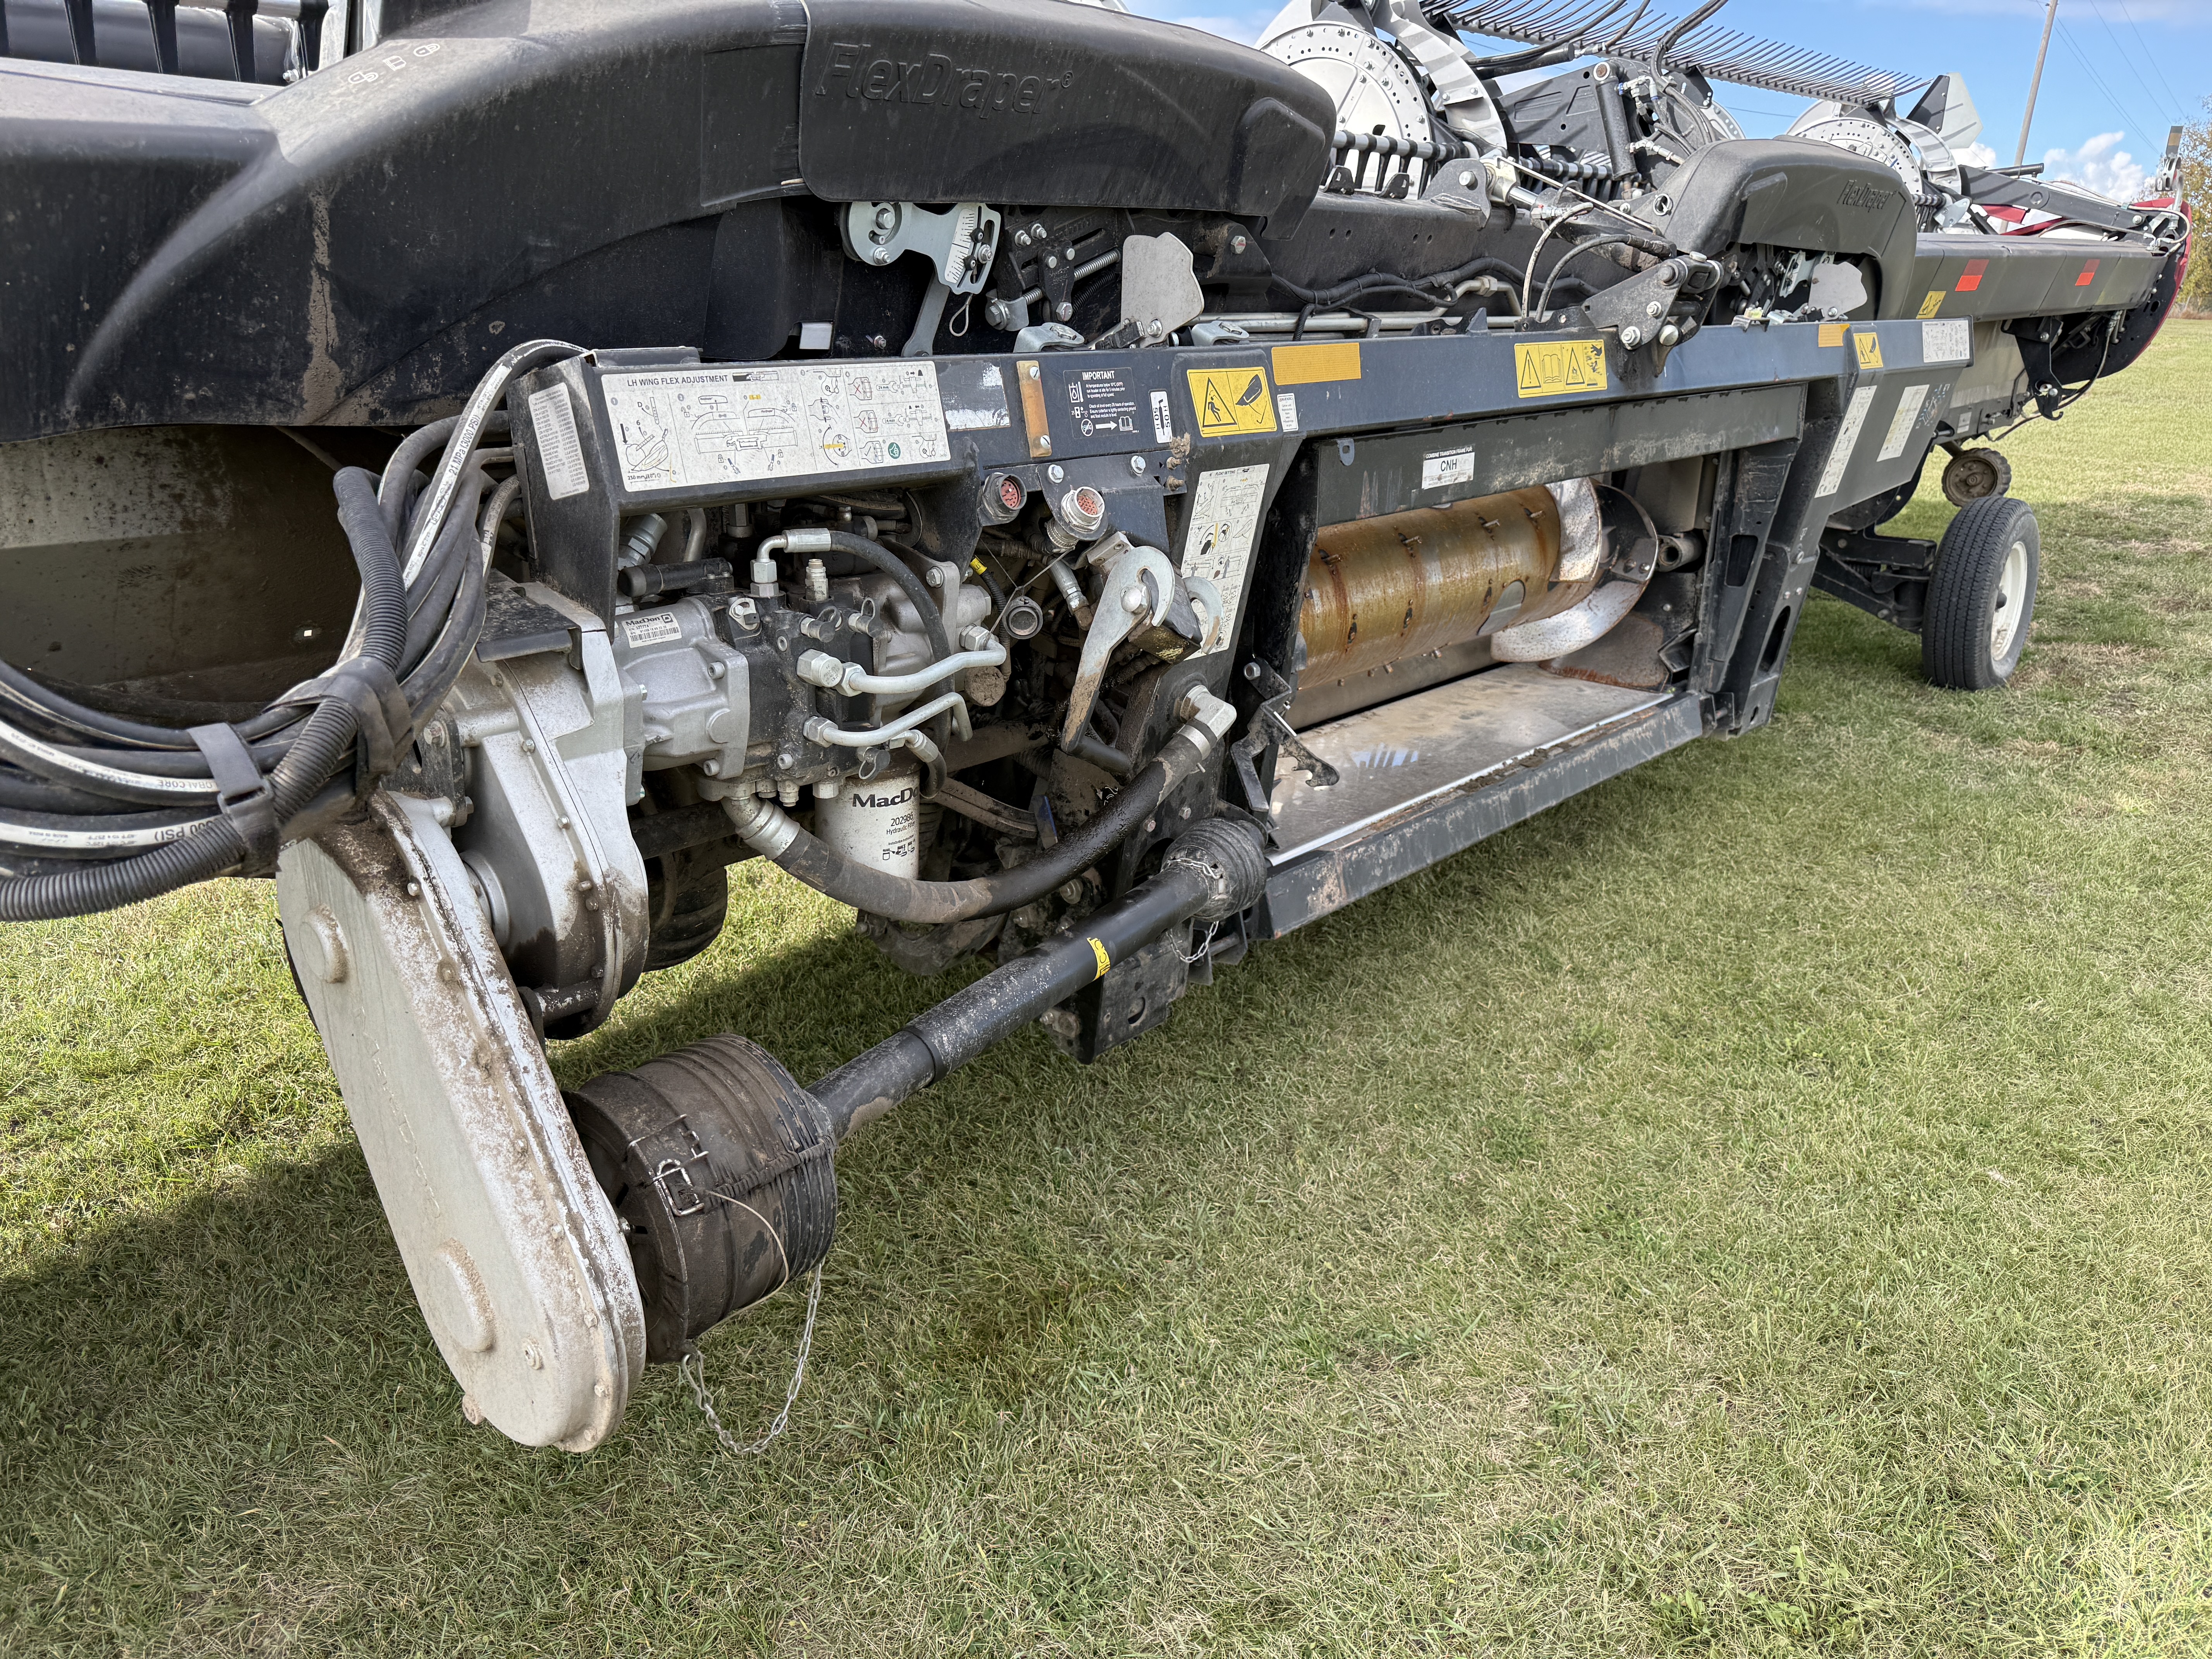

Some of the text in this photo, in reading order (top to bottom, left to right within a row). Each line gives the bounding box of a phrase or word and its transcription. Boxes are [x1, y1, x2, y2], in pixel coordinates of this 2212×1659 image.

[639, 378, 659, 386] WING
[682, 375, 728, 384] ADJUSTMENT
[1082, 371, 1115, 380] IMPORTANT
[452, 448, 465, 465] MPa
[449, 465, 459, 476] 21
[1441, 459, 1457, 472] CNH
[626, 617, 660, 626] MacDon
[157, 779, 218, 790] LOBALCORE
[852, 787, 919, 808] MacDo
[891, 812, 913, 826] 202986
[155, 827, 184, 842] PSI)
[886, 825, 907, 835] Hydraulic
